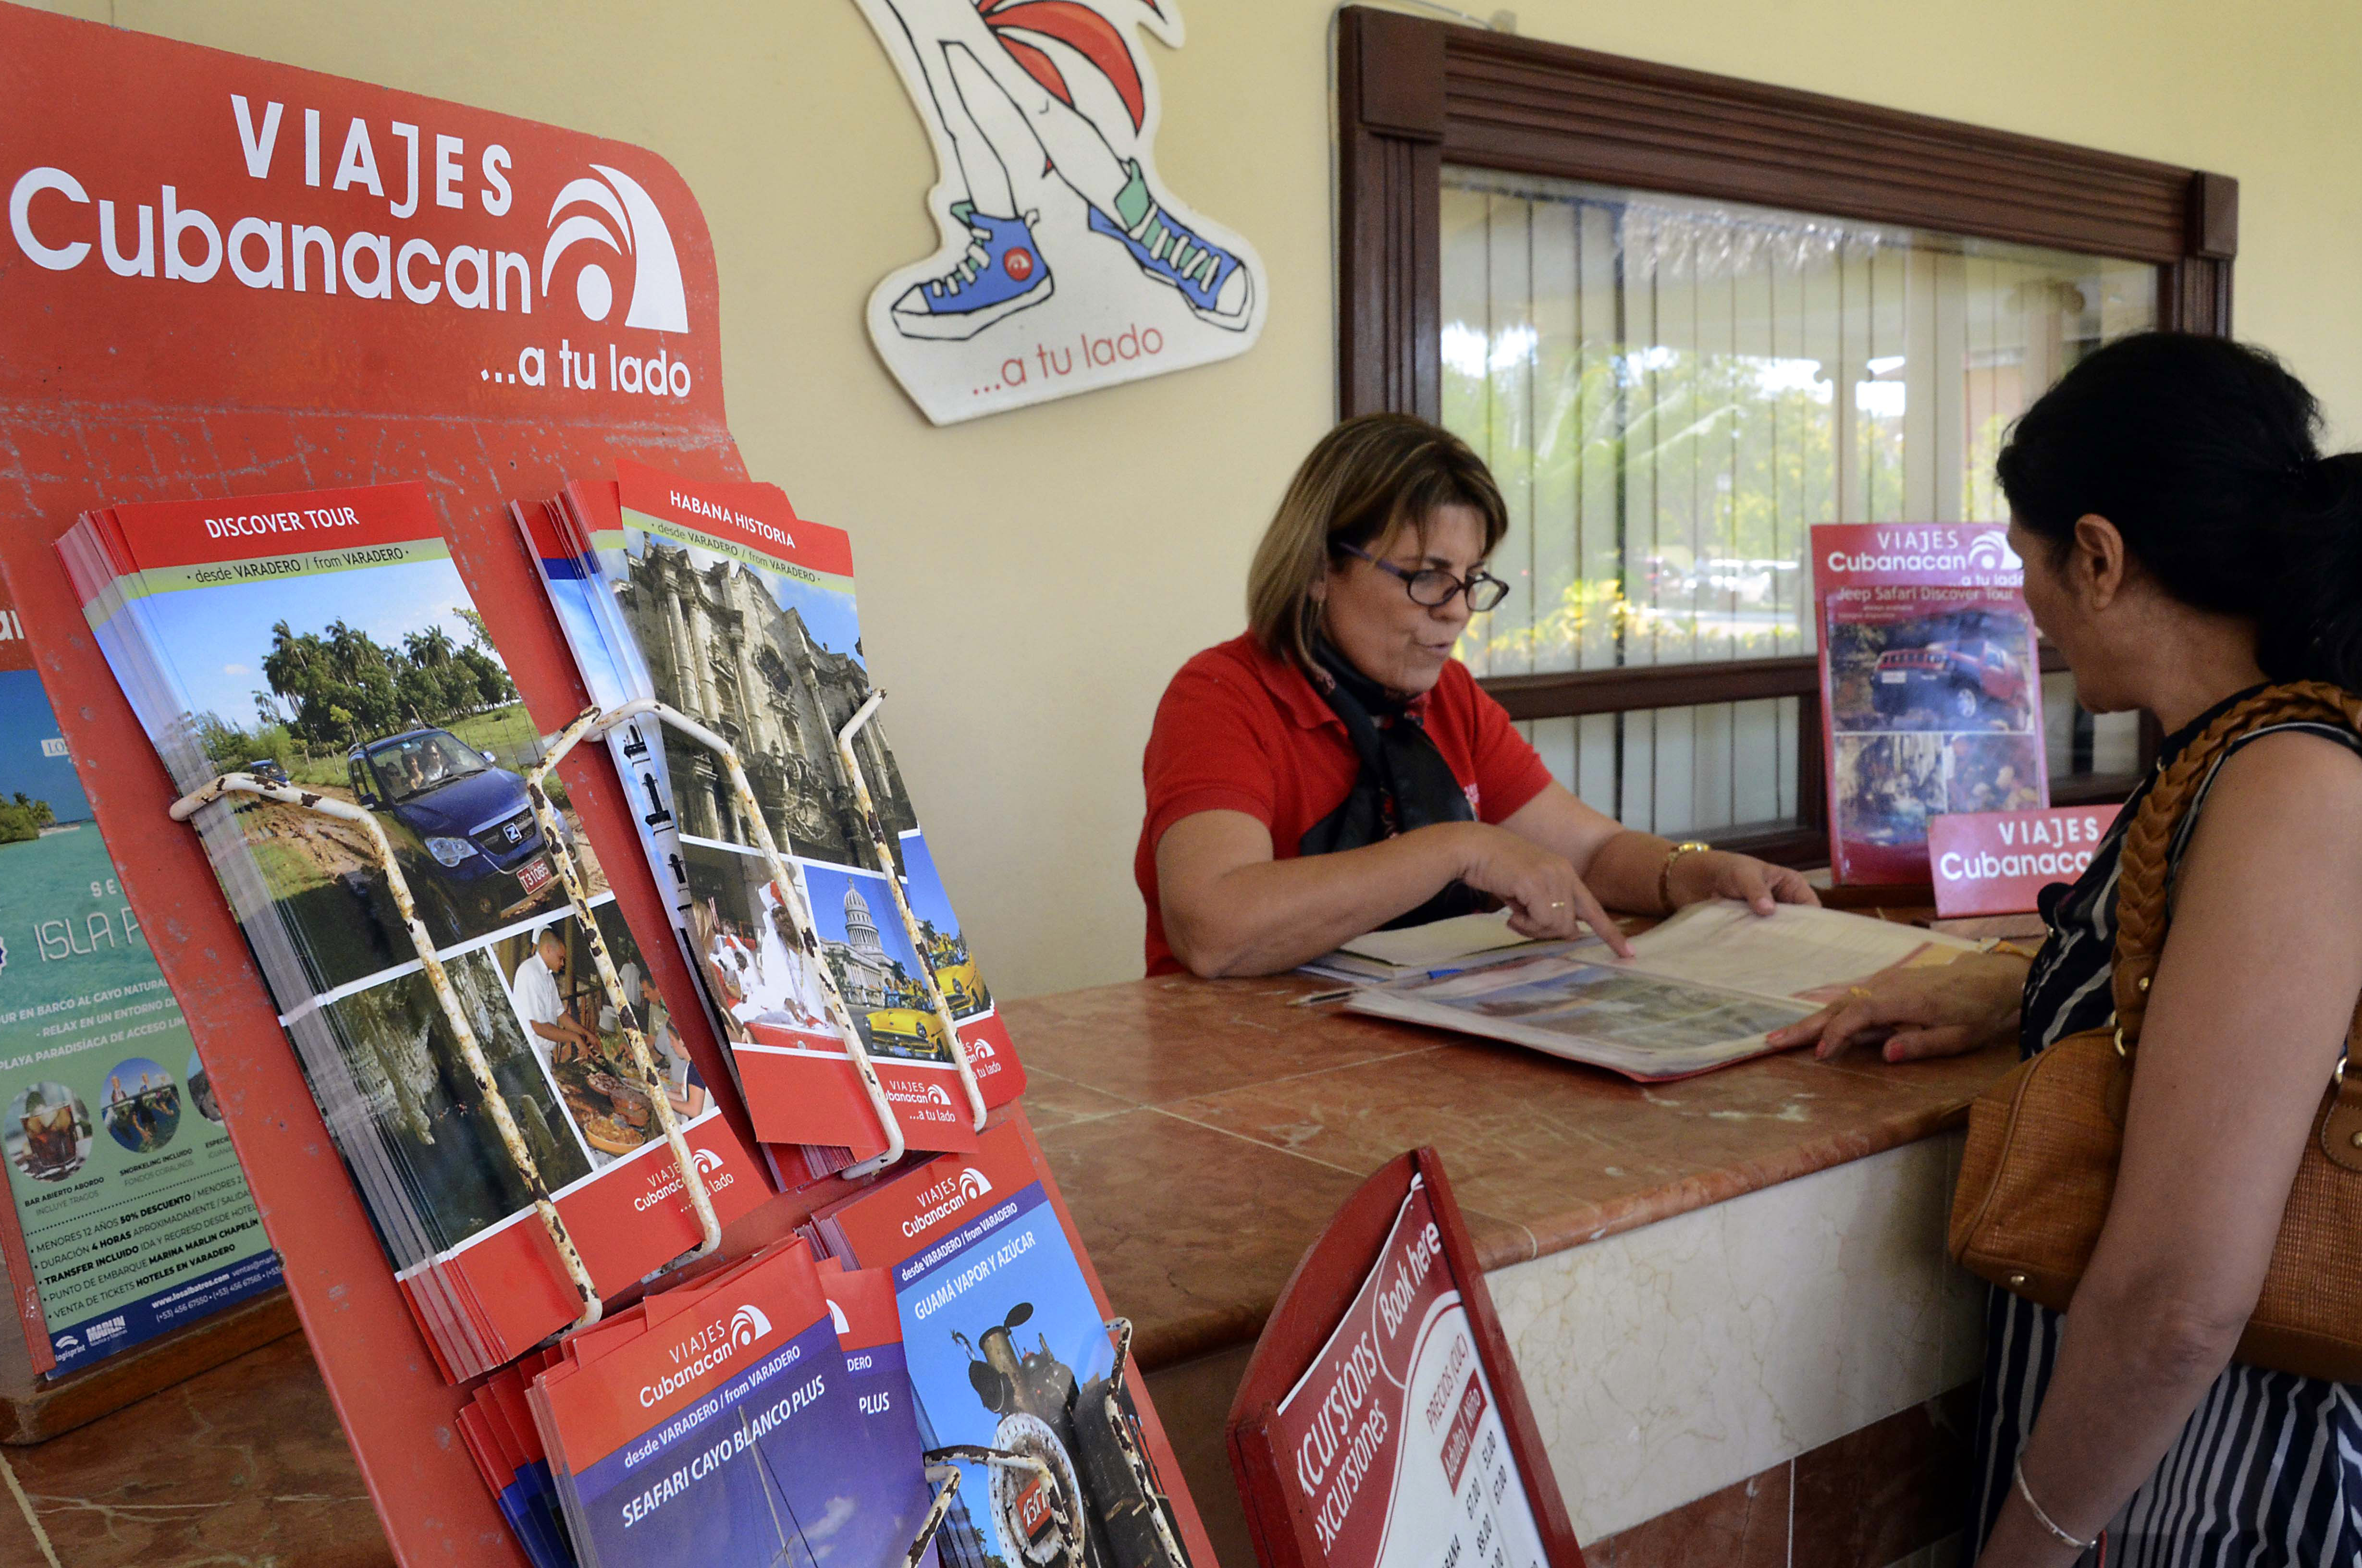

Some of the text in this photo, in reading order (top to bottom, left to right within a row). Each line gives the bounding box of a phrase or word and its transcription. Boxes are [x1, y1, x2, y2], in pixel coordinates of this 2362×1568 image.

[231, 94, 512, 219] VIAJES
[10, 167, 531, 314] Cubanacan
[481, 339, 691, 397] ...a tu lado
[973, 324, 1163, 396] ...a tu lado
[205, 507, 359, 539] DISCOVER TOUR
[670, 490, 796, 549] HABANA HISTORIA
[658, 522, 686, 540] desde
[688, 532, 738, 556] VARADERO
[749, 551, 769, 567] from
[770, 559, 816, 582] VARADERO
[1878, 531, 1959, 551] VIAJES
[196, 567, 233, 583] desde
[234, 559, 301, 578] VARADERO
[313, 556, 342, 569] from
[343, 547, 404, 566] VARADERO
[1828, 551, 1967, 573] Cubanacan
[1976, 575, 1990, 586] tu
[1836, 586, 2013, 602] Jeep Safari Discover Tour
[1998, 816, 2099, 848] VIAJES
[1940, 851, 2092, 880] Cubanaca
[34, 912, 115, 961] ISLA
[0, 978, 168, 1024] UR EN BARCO AL CAYO NATURAL
[43, 1021, 77, 1037] RELAX
[80, 1016, 94, 1028] EN
[97, 1012, 112, 1024] UN
[114, 1000, 162, 1019] ENTORNO
[36, 1036, 108, 1061] PARADISÍACA
[111, 1031, 124, 1043] DE
[127, 1021, 166, 1039] ACCESO
[889, 1080, 925, 1092] VIAJES
[977, 1067, 985, 1078] tu
[986, 1061, 1001, 1076] lado
[926, 1109, 935, 1121] tu
[937, 1109, 956, 1122] lado
[120, 1148, 193, 1176] SNORKELING INCLUIDO
[647, 1161, 681, 1187] VIAJE
[709, 1173, 734, 1192] lado
[25, 1177, 104, 1207] BAR ABIERTO ABORDO
[36, 1190, 99, 1216] INCLUYE TRAGOS
[917, 1178, 956, 1208] VIAJES
[37, 1232, 82, 1253] MENORES
[83, 1228, 92, 1237] 12
[94, 1218, 119, 1233] AÑOS
[120, 1212, 139, 1224] 50%
[140, 1194, 191, 1217] DESCUENTO
[197, 1178, 236, 1197] MENORES
[40, 1245, 90, 1269] DURACIÓN
[100, 1231, 132, 1248] HORAS
[134, 1201, 216, 1237] APROXIMADAMENTE
[902, 1195, 965, 1238] Cubanacan
[44, 1262, 94, 1285] TRANSFER
[96, 1246, 139, 1267] INCLUIDO
[140, 1239, 156, 1251] IDA
[164, 1223, 202, 1242] REGRESO
[203, 1213, 230, 1228] DESDE
[49, 1218, 259, 1301] PUNTO DE EMBARQUE MARINA MARLIN CHAPELÍN
[901, 1261, 925, 1281] desde
[922, 1236, 961, 1268] VARADERO
[964, 1226, 983, 1242] from
[980, 1202, 1018, 1233] VARADERO
[53, 1244, 235, 1318] VENTA DE TICKETS HOTELES EN VARADERO
[151, 1273, 230, 1309] www.losalbatros.com
[174, 1303, 188, 1314] 456
[188, 1295, 209, 1308] 67550
[230, 1281, 242, 1291] 456
[243, 1274, 262, 1286] 67565
[914, 1231, 1036, 1320] GUAMÁ VAPOR Y AZÚCAR
[55, 1344, 86, 1362] logisprint
[669, 1320, 726, 1364] VIAJES
[1297, 1222, 1441, 1497] xcursions Book here
[640, 1341, 732, 1408] Cubanacan
[1426, 1333, 1469, 1435] PRECIOS (CUC)
[625, 1439, 660, 1469] desde
[658, 1398, 719, 1446] VARADERO
[724, 1382, 750, 1404] from
[748, 1345, 800, 1391] VARADERO
[859, 1392, 890, 1415] PLUS
[622, 1375, 825, 1528] SEAFARI CAYO BLANCO PLUS
[1444, 1388, 1480, 1484] Adulto Niño
